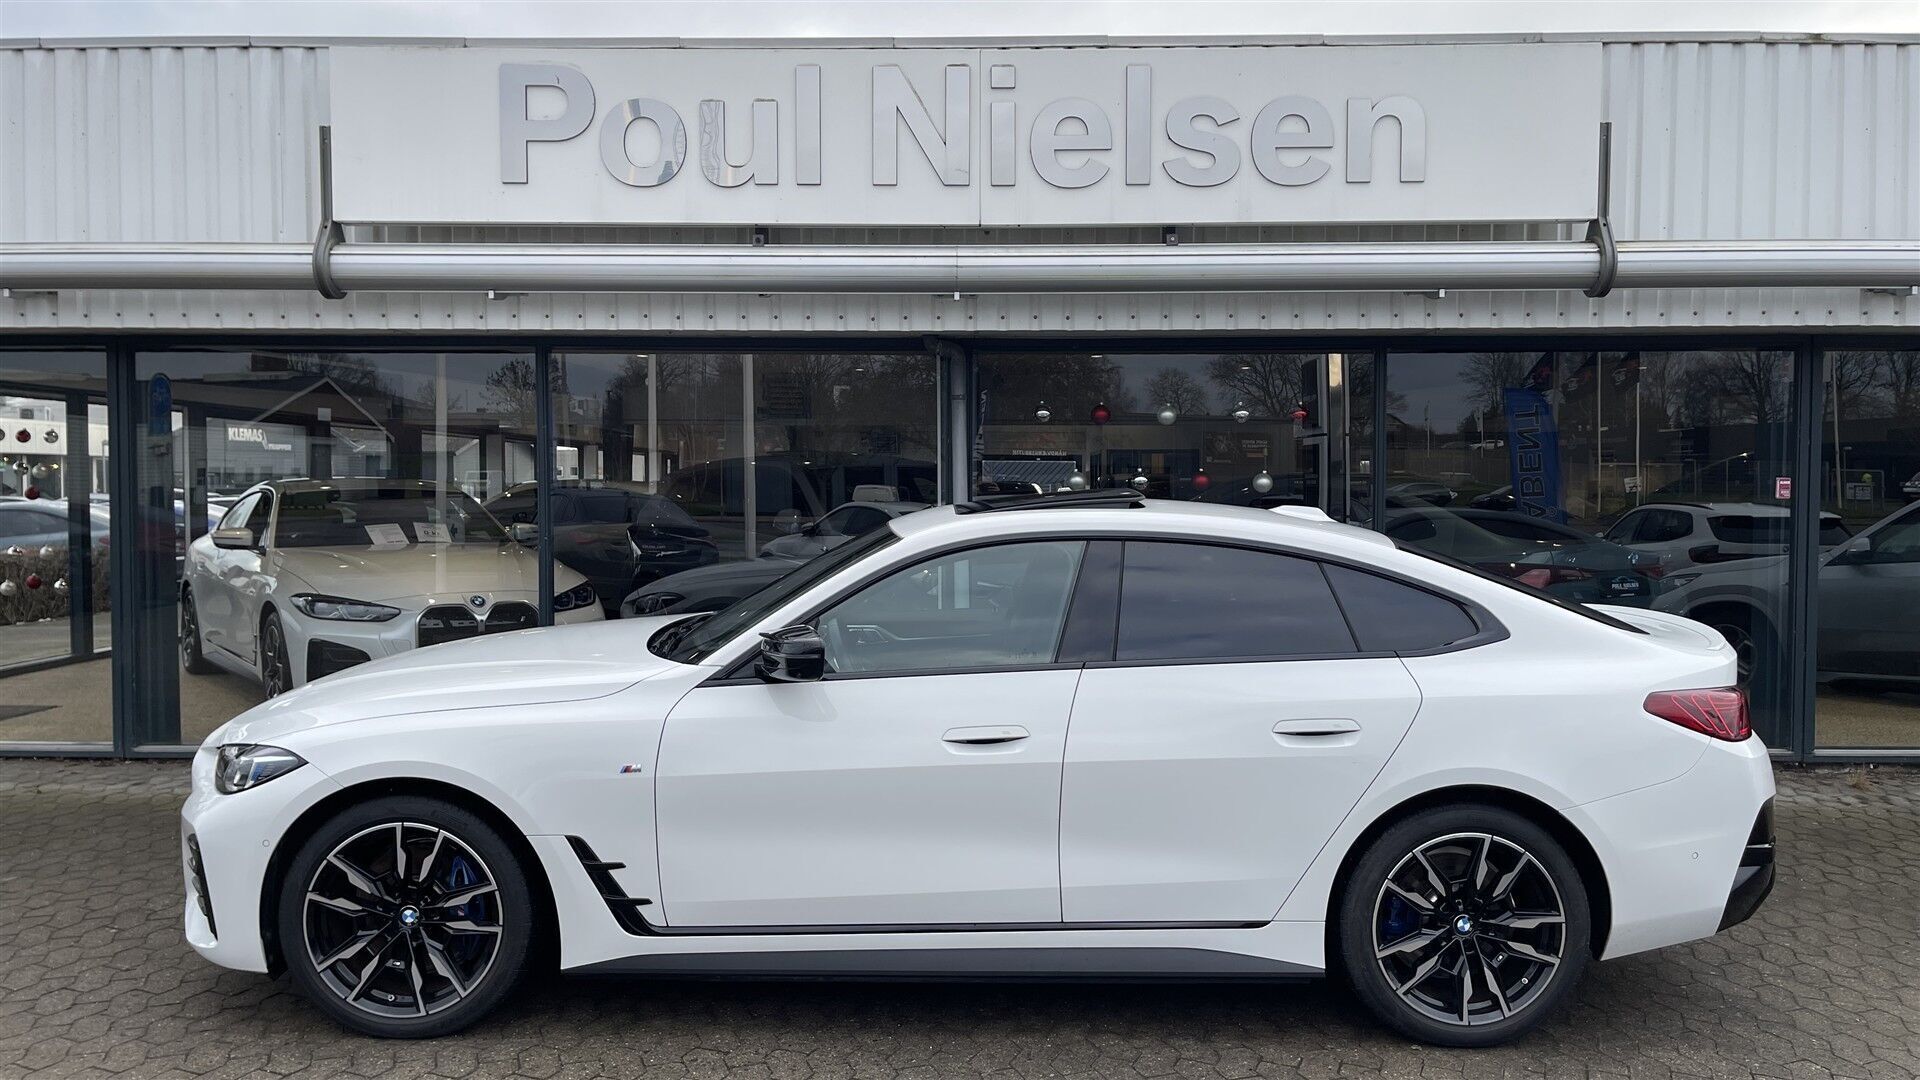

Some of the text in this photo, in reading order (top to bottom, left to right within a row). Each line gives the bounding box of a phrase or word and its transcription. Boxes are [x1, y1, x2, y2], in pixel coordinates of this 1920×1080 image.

[500, 62, 1428, 189] Poul Nielsen
[228, 427, 263, 442] KLEMAS
